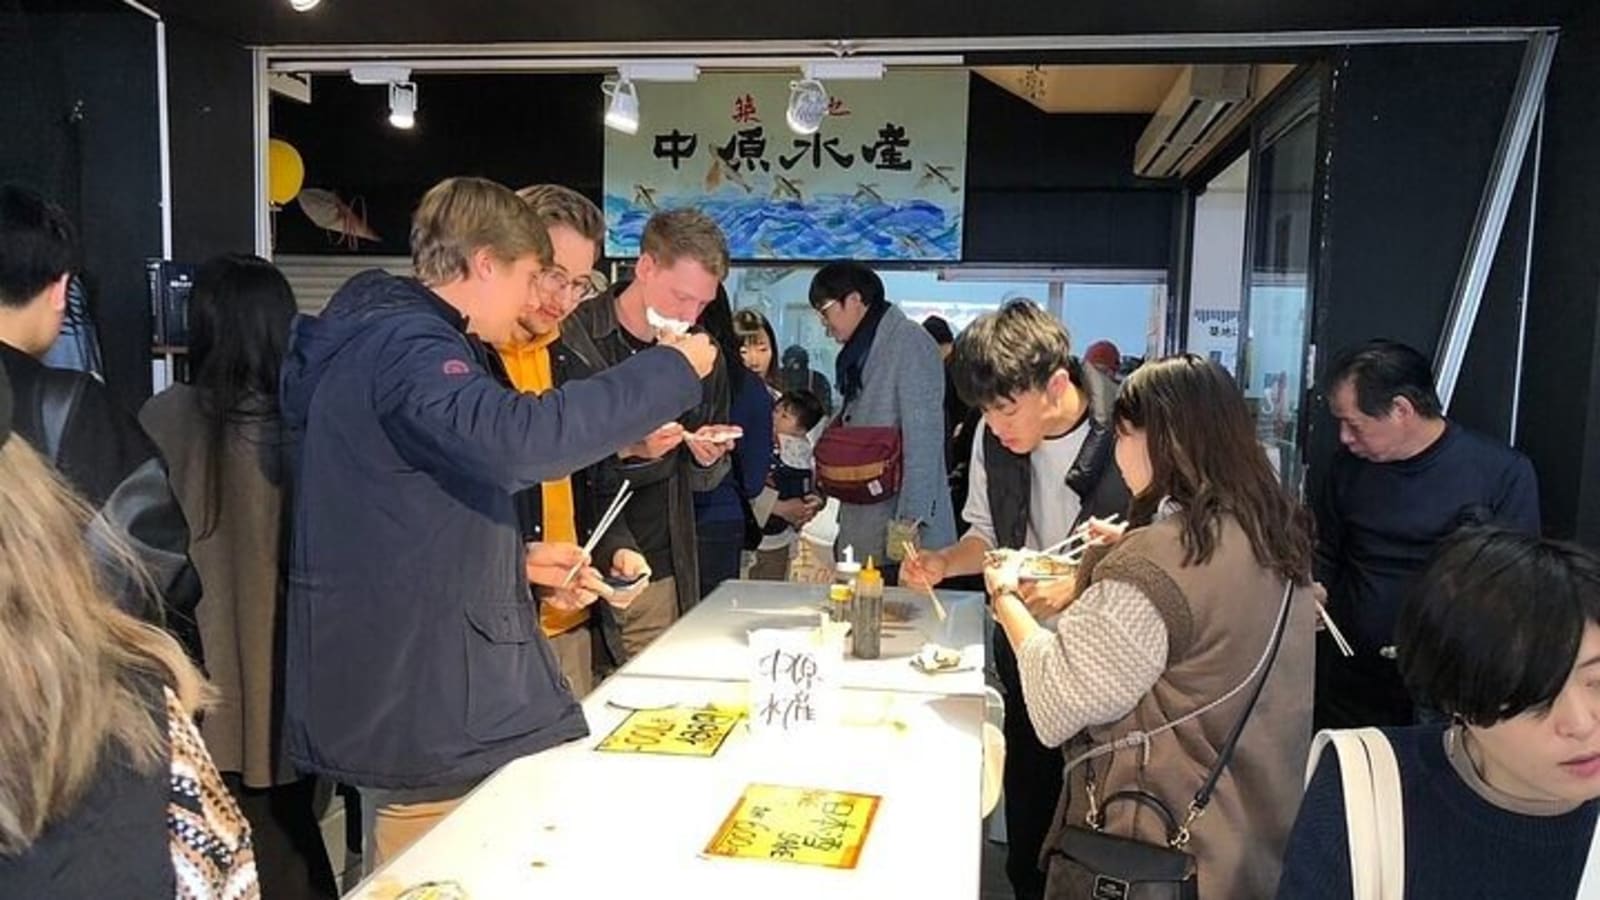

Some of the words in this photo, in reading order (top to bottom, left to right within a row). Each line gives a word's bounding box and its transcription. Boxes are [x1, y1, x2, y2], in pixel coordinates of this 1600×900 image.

[653, 122, 912, 171] 中原水産
[802, 800, 857, 851] 日本酒
